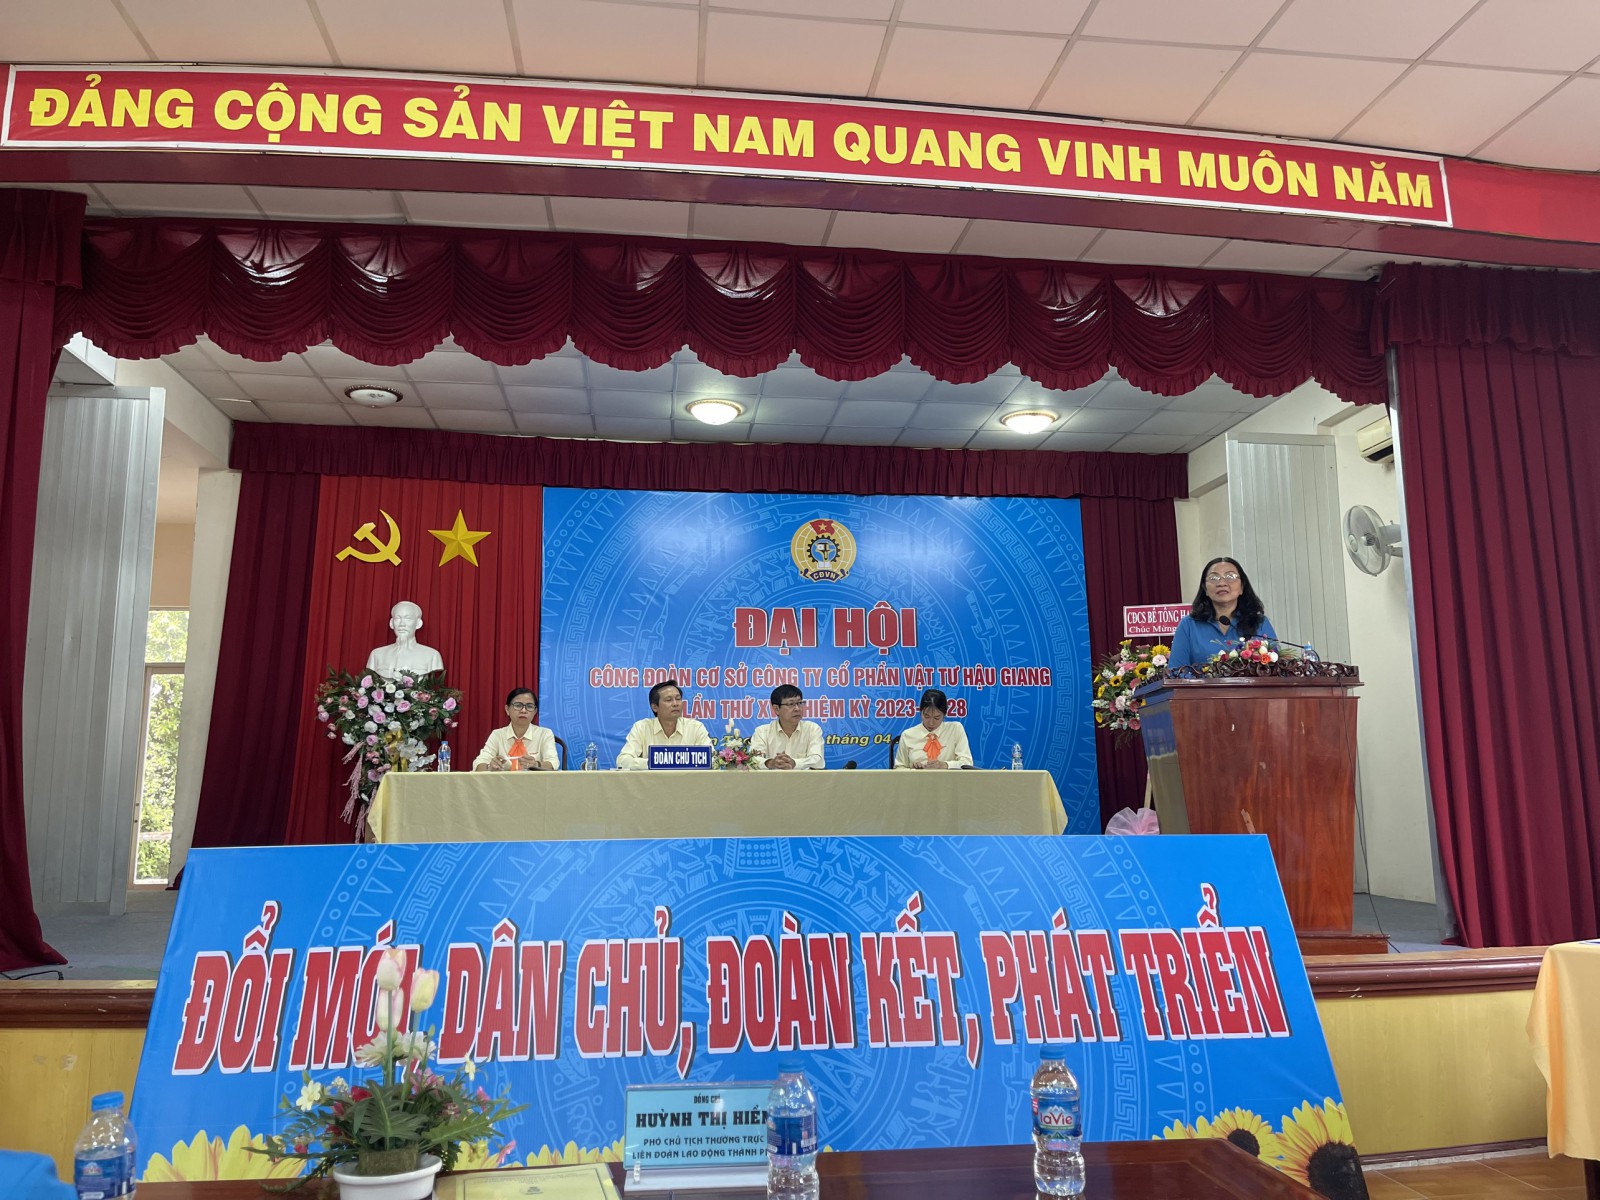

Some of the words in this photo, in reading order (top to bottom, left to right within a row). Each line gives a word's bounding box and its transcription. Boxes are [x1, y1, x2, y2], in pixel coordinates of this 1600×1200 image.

[30, 75, 193, 128] ĐẢNG
[215, 83, 381, 142] CỘNG
[404, 86, 520, 141] SẢN
[544, 100, 673, 158] VIỆT
[694, 114, 813, 157] NAM
[834, 123, 1020, 171] QUANG
[1039, 139, 1160, 183] VINH
[1179, 151, 1317, 196] MUÔN
[1334, 162, 1432, 207] NĂM
[1127, 611, 1146, 624] CĐCS
[1158, 606, 1179, 623] TÔNG
[732, 607, 817, 655] ĐẠI
[833, 600, 917, 655] HỘI
[590, 664, 639, 688] CÔNG
[643, 664, 692, 687] ĐOÀN
[696, 666, 720, 687] CƠ
[724, 662, 748, 687] SỞ
[752, 664, 799, 687] CÔNG
[802, 667, 823, 687] TY
[827, 660, 850, 687] CỔ
[854, 661, 899, 687] PHẦN
[904, 663, 934, 690] VẬT
[938, 665, 960, 686] TƯ
[963, 663, 997, 691] HẬU
[1001, 667, 1052, 687] GIANG
[682, 693, 716, 719] LẦN
[721, 697, 755, 719] THỨ
[801, 695, 845, 723] HIỆM
[849, 695, 871, 718] KỲ
[875, 698, 967, 718] 2023-28
[825, 734, 869, 746] tháng
[874, 733, 892, 745] 04
[653, 749, 673, 765] ĐOÀN
[675, 748, 689, 764] CHỦ
[690, 752, 707, 767] TỊCH
[172, 900, 294, 1076] ĐỔI
[437, 917, 565, 1064] DÂN
[574, 905, 694, 1079] CHỦ,
[706, 911, 855, 1054] ĐOÀN
[860, 891, 981, 1069] KẾT,
[980, 907, 1122, 1046] PHÁT
[1119, 883, 1293, 1041] TRIỂN
[636, 1108, 692, 1128] HUỲNH
[698, 1111, 727, 1130] THỊ
[685, 1137, 703, 1147] TỊCH
[682, 1150, 699, 1158] LAO
[701, 1148, 725, 1160] ĐỘNG
